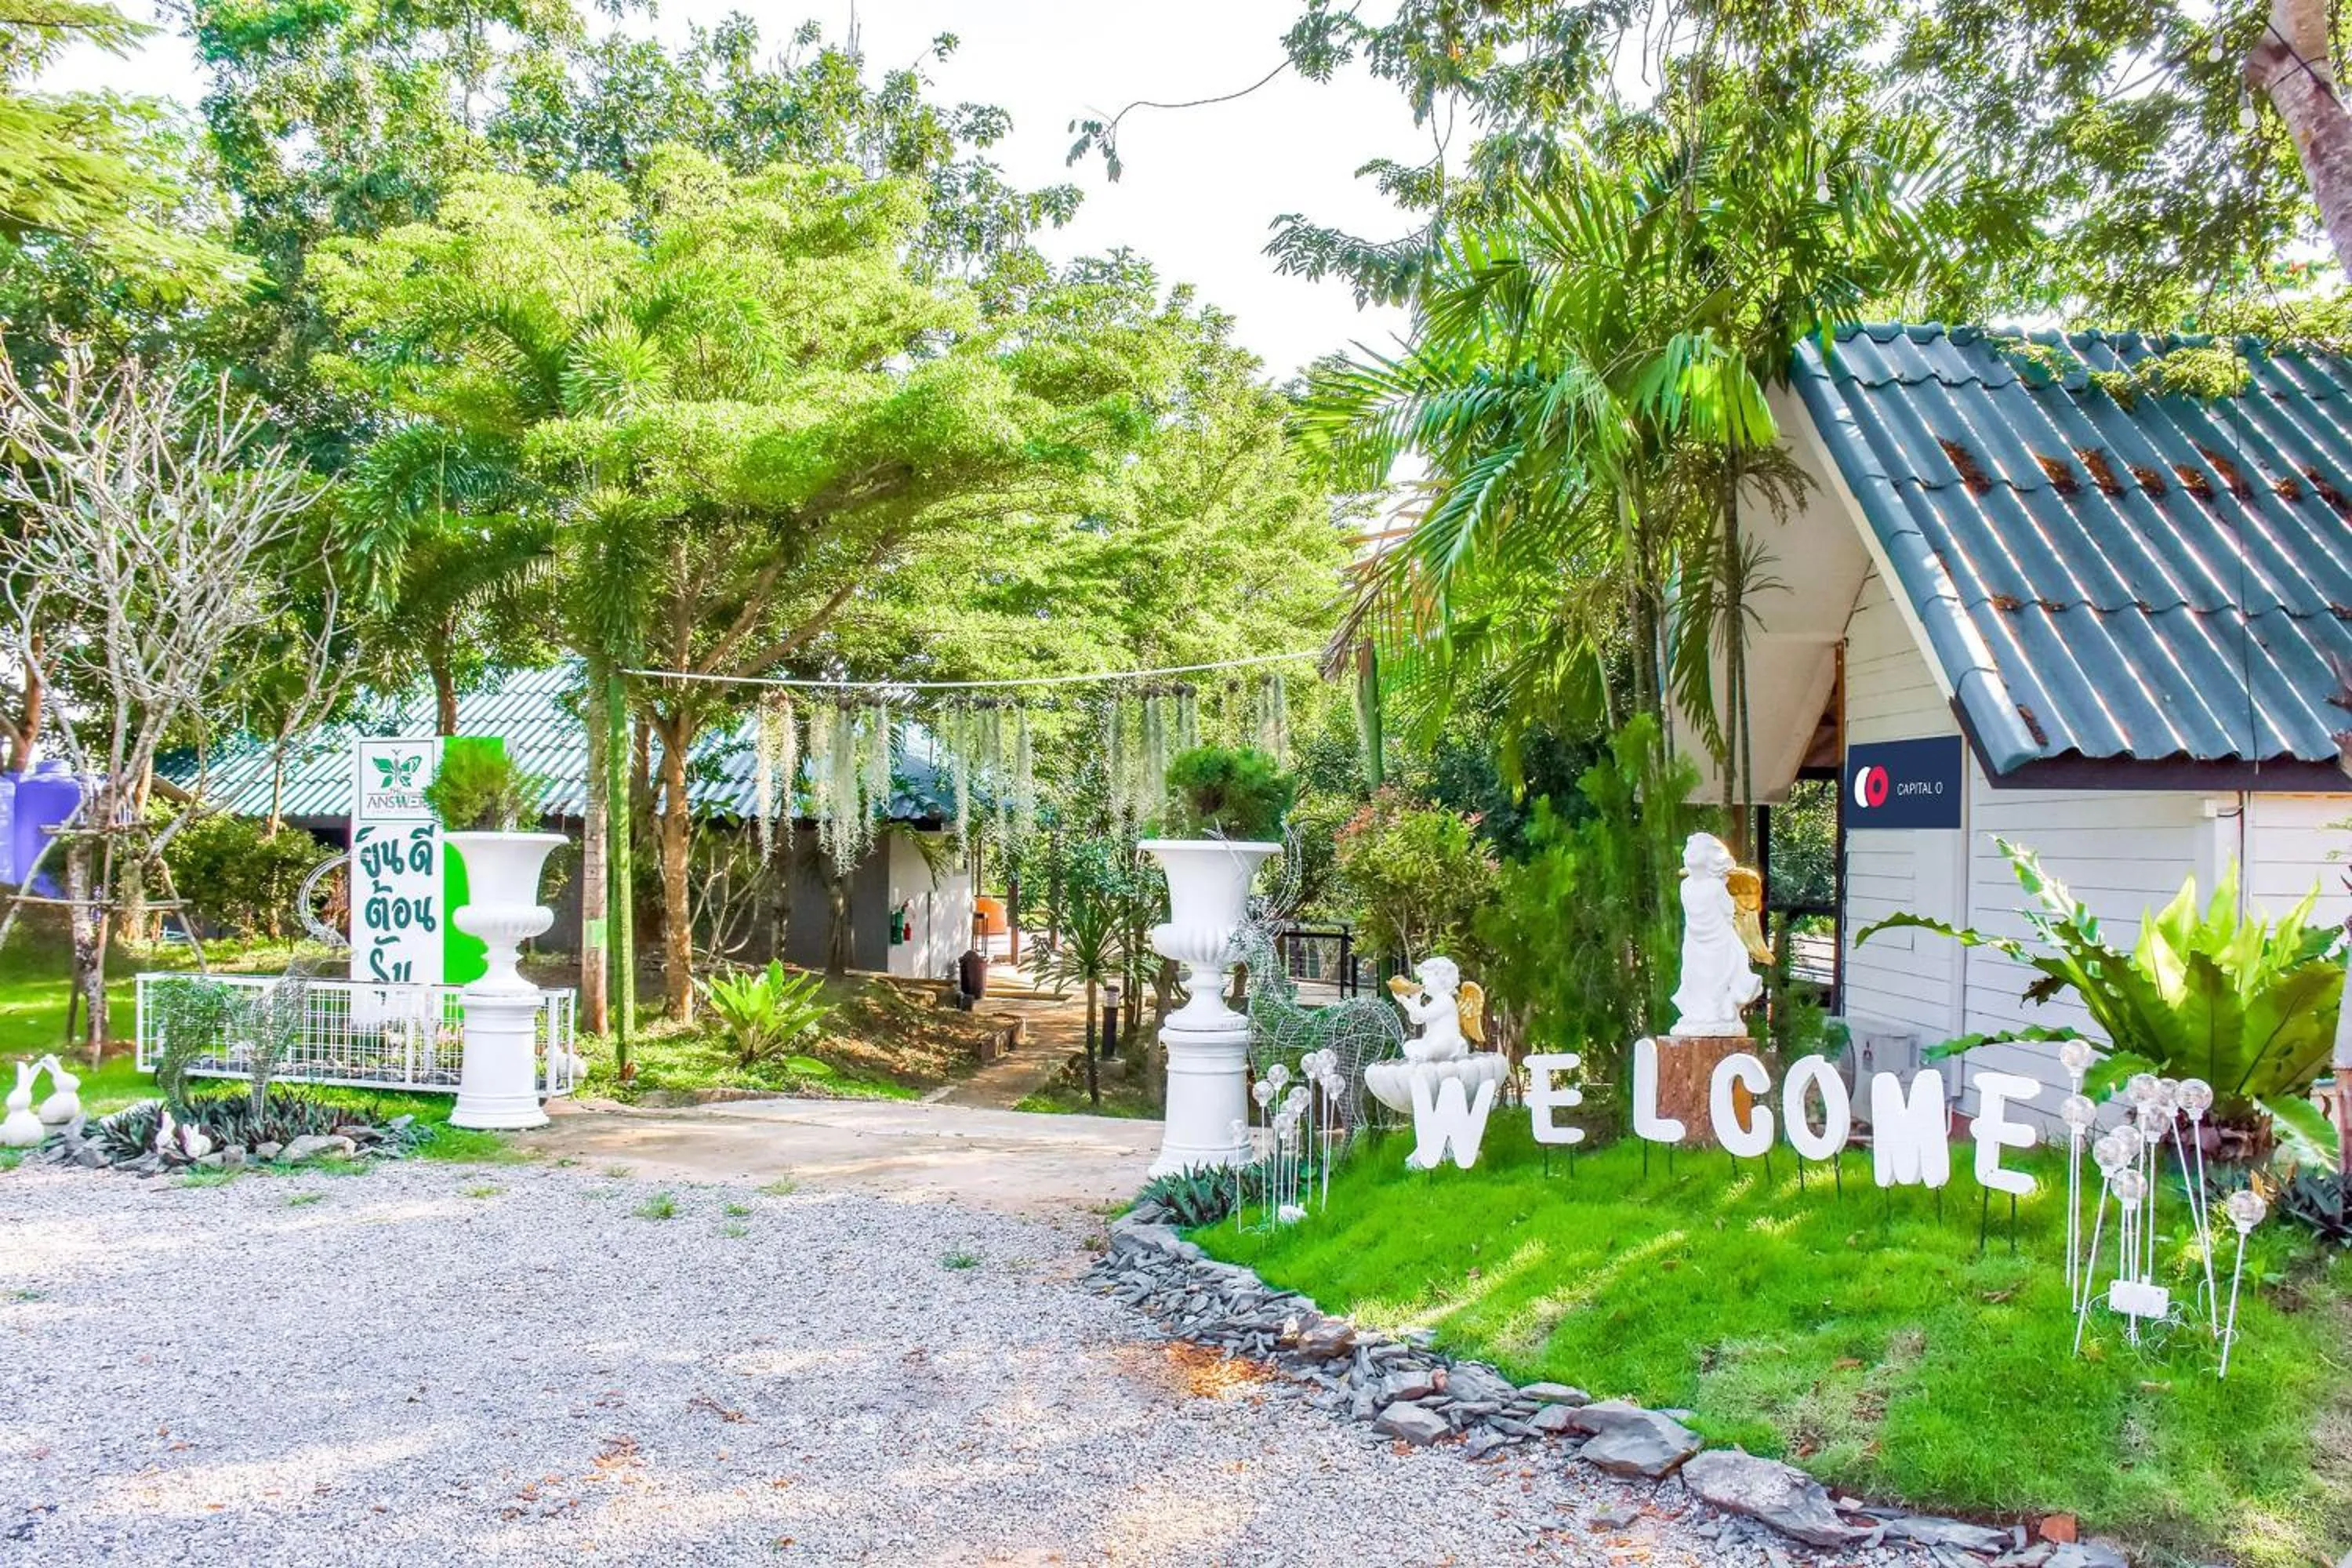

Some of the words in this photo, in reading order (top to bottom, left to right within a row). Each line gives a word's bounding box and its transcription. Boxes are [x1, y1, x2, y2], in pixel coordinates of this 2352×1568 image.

[1896, 782, 1933, 796] CAPITAL
[1935, 782, 1944, 794] O
[354, 825, 435, 878] ยินดี
[365, 880, 437, 932] ต้อน
[1410, 1037, 2041, 1196] WELCOME
